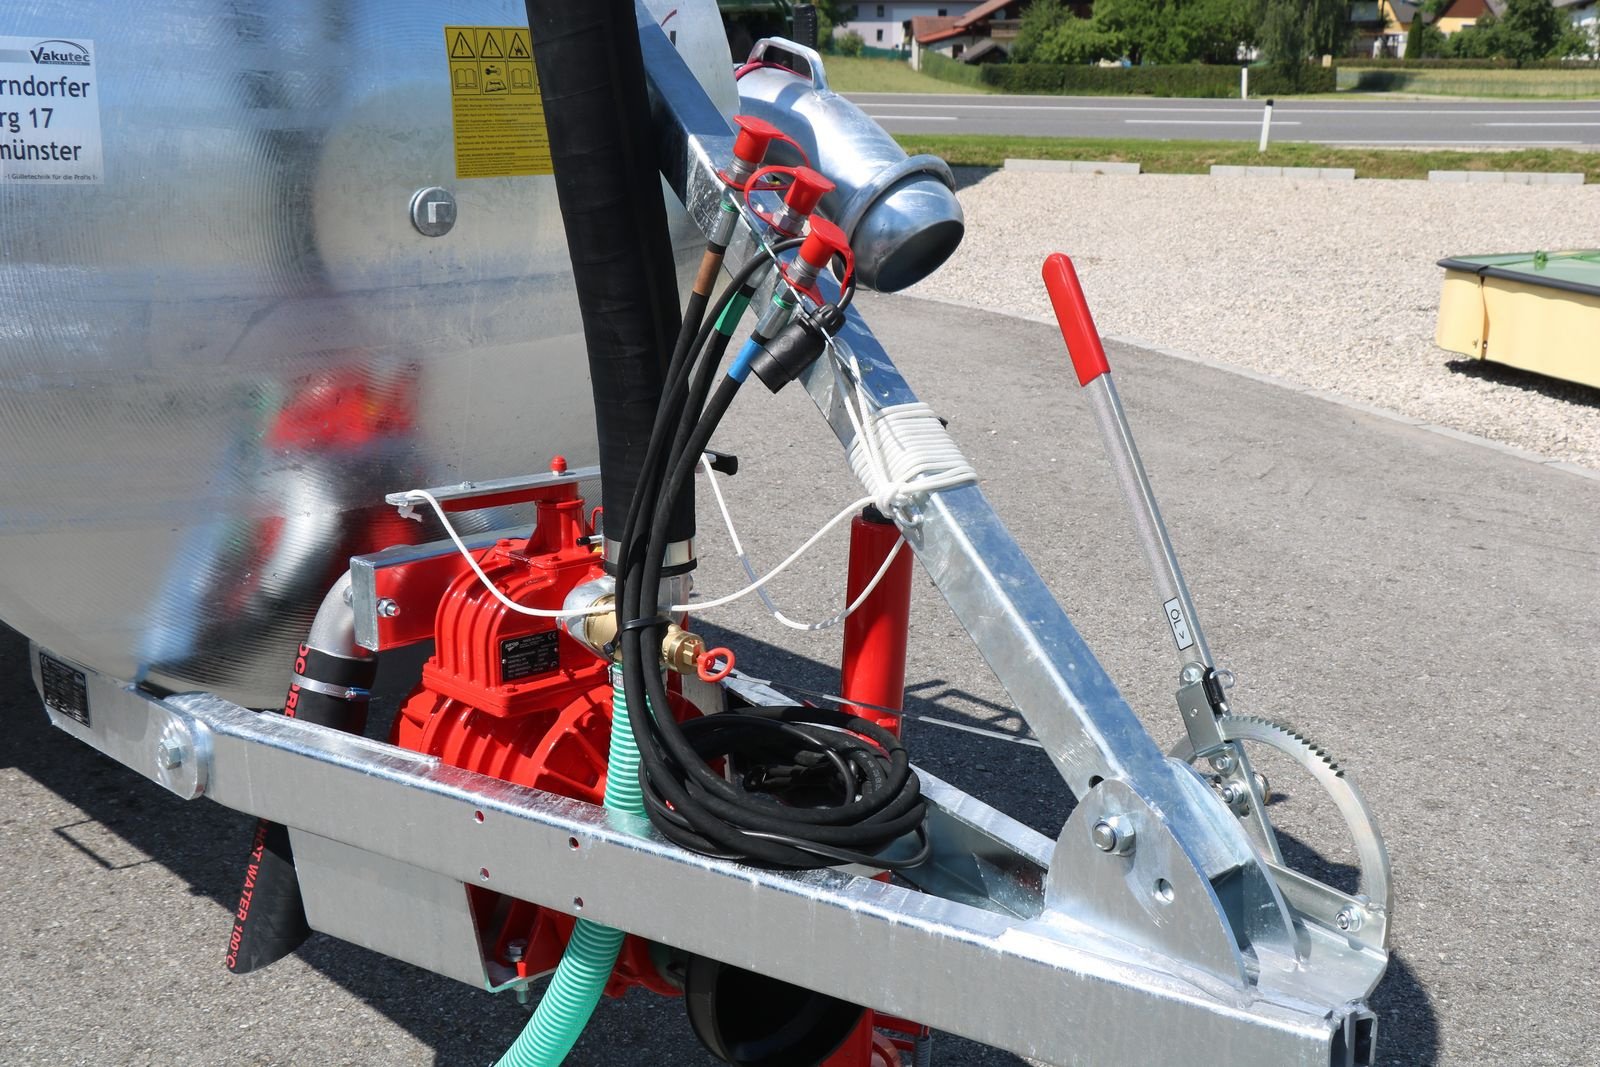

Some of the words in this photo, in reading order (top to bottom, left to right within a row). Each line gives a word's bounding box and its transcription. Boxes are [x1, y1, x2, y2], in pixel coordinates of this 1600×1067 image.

[30, 47, 91, 64] Vakutec
[29, 107, 54, 129] 17
[236, 863, 259, 923] WATER
